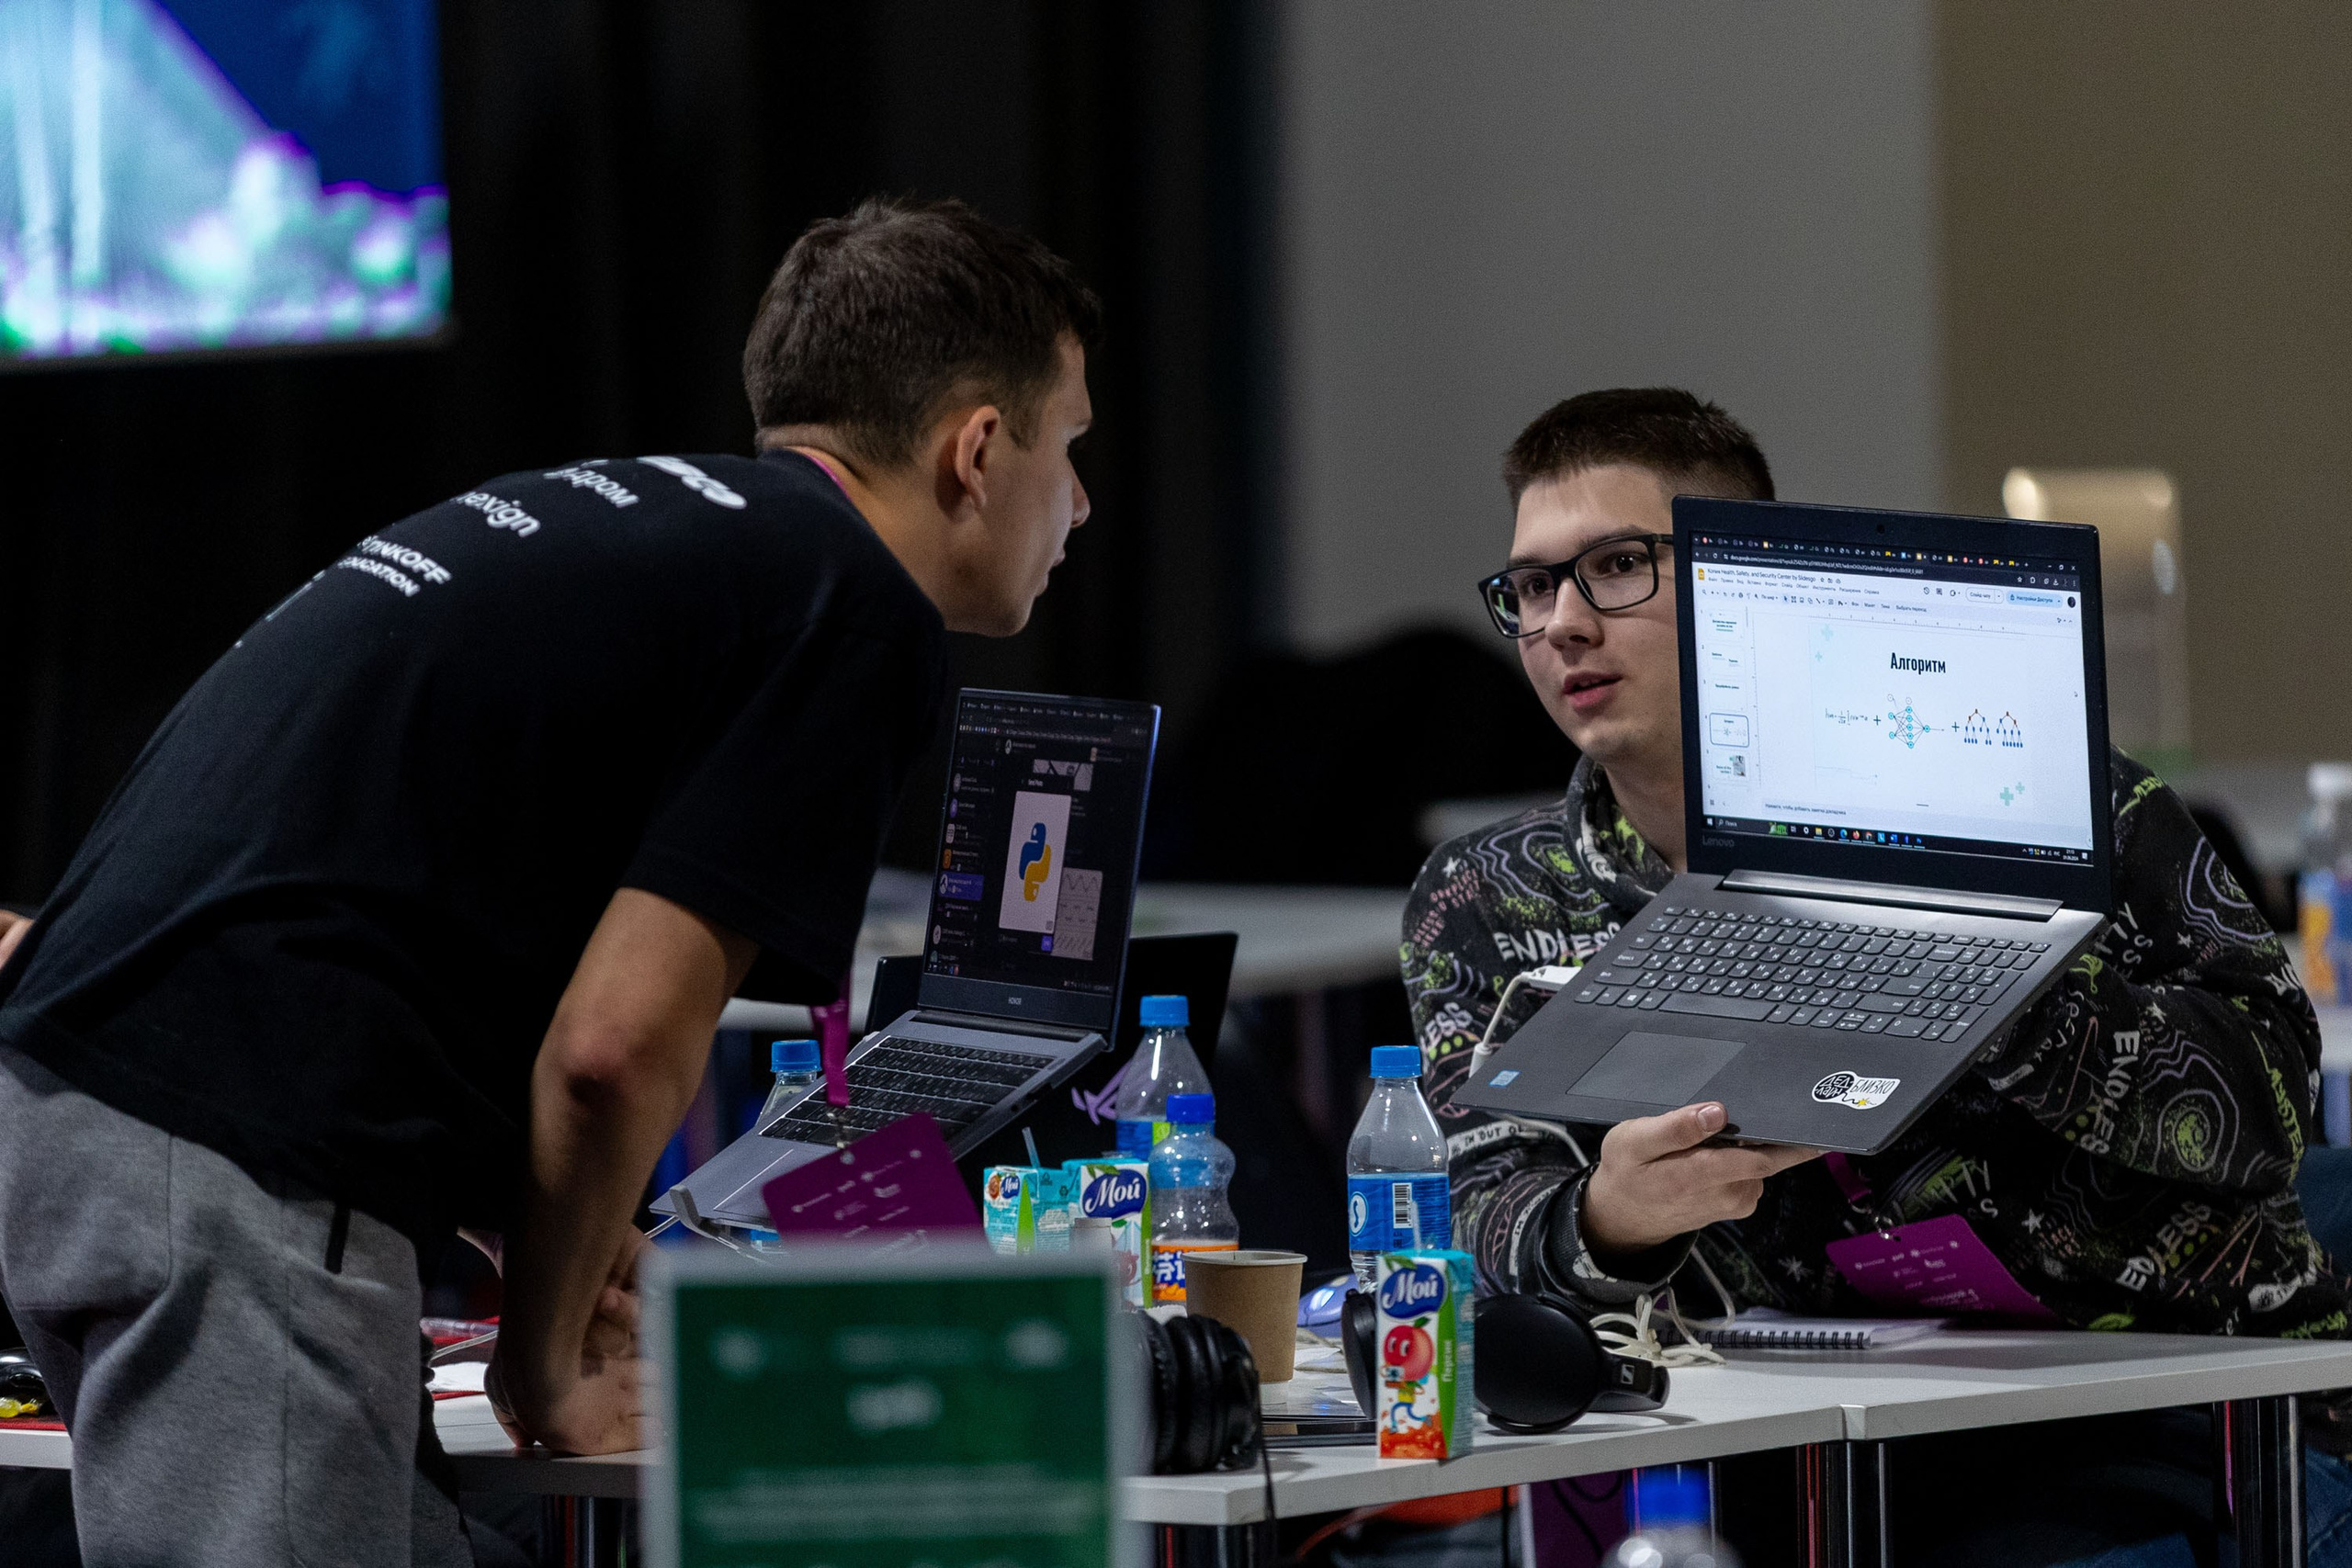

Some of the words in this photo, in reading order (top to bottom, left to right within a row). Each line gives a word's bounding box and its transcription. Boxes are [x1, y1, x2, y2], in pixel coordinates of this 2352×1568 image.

[1792, 574, 1798, 582] by
[1798, 575, 1816, 583] Slidesgo
[1891, 652, 1946, 675] Алгоритм
[1702, 834, 1735, 847] Lenovo
[1850, 1078, 1895, 1095] БЛИЗКО
[1001, 1177, 1020, 1193] Мой
[1084, 1174, 1141, 1213] Мой
[1382, 1270, 1439, 1309] Мой
